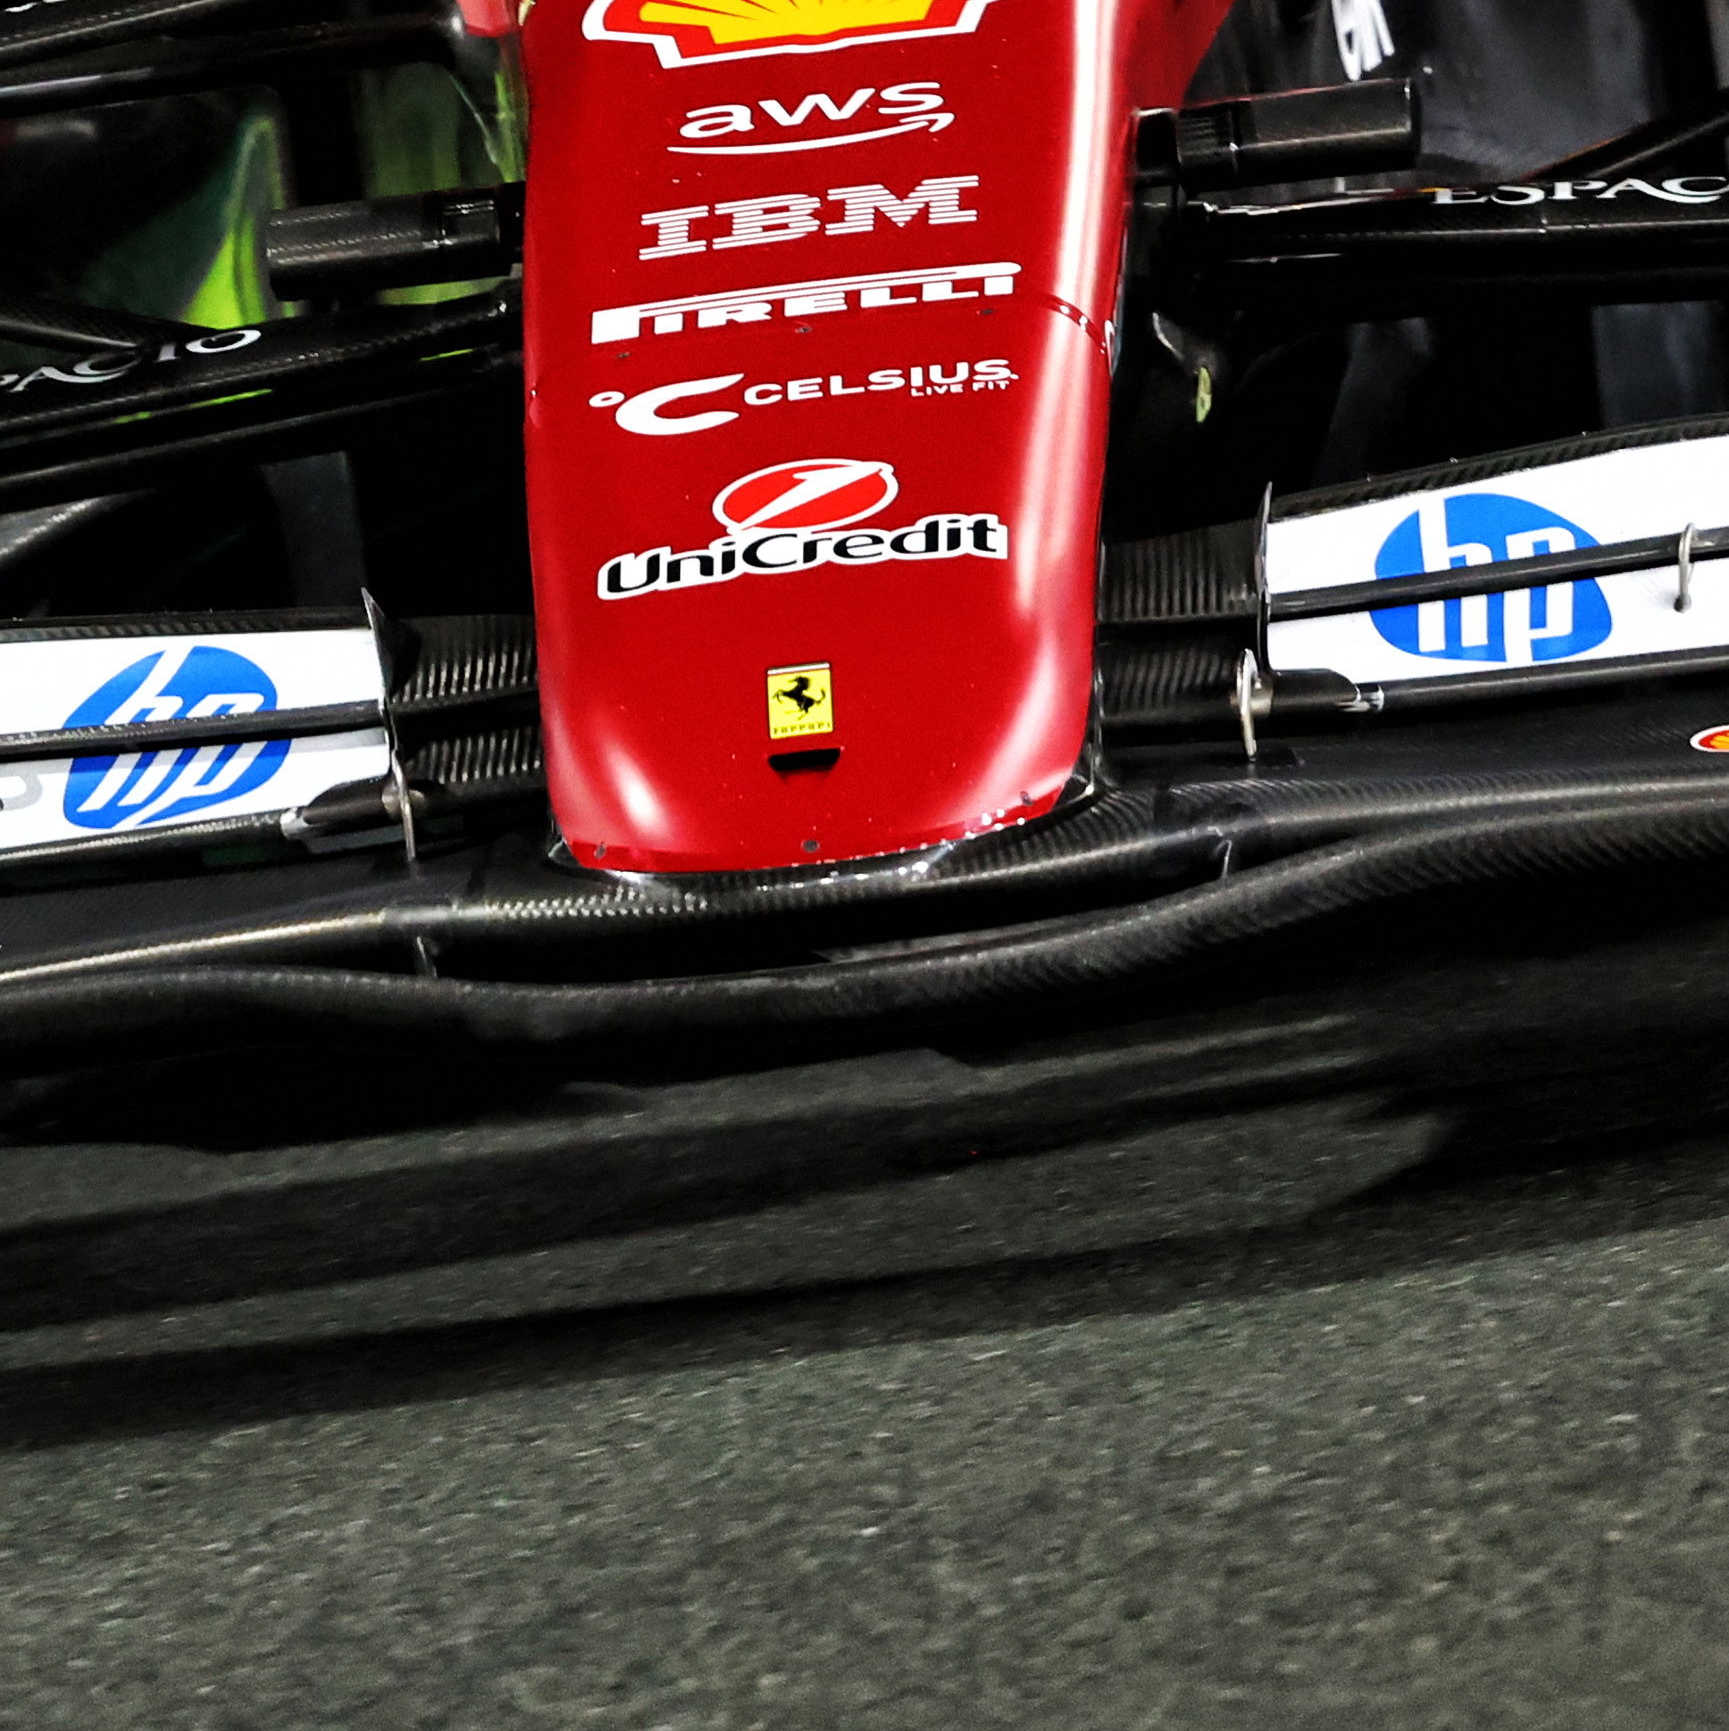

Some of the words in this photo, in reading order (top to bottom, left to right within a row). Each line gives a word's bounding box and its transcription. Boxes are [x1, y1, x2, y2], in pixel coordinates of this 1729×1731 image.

[679, 81, 947, 138] aws
[638, 175, 979, 261] IBM
[591, 262, 1022, 345] PIRELLI
[744, 359, 1013, 408] CELSIUS
[911, 383, 962, 398] LIVE
[973, 379, 1011, 394] FIT
[606, 518, 1000, 595] UniCredit
